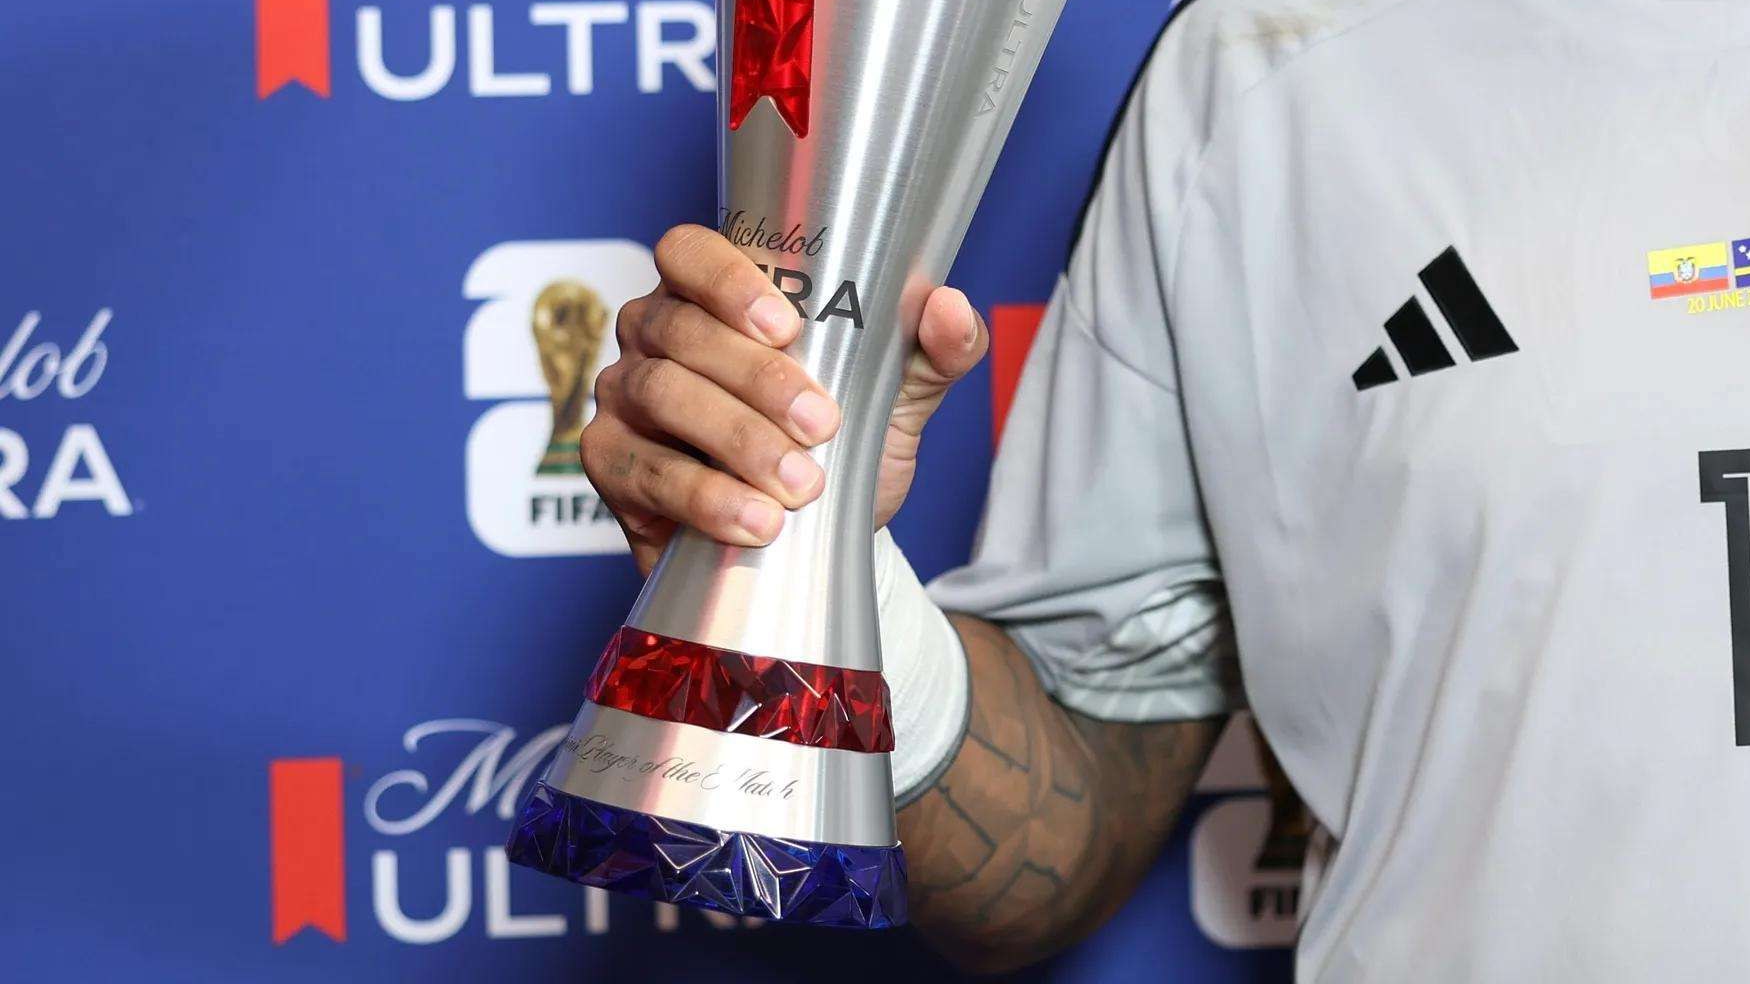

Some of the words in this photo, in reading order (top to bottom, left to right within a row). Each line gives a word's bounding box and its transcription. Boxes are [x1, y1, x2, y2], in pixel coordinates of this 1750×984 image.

[356, 0, 718, 101] ULTR
[1687, 297, 1705, 314] 20
[1706, 291, 1745, 313] JUNE
